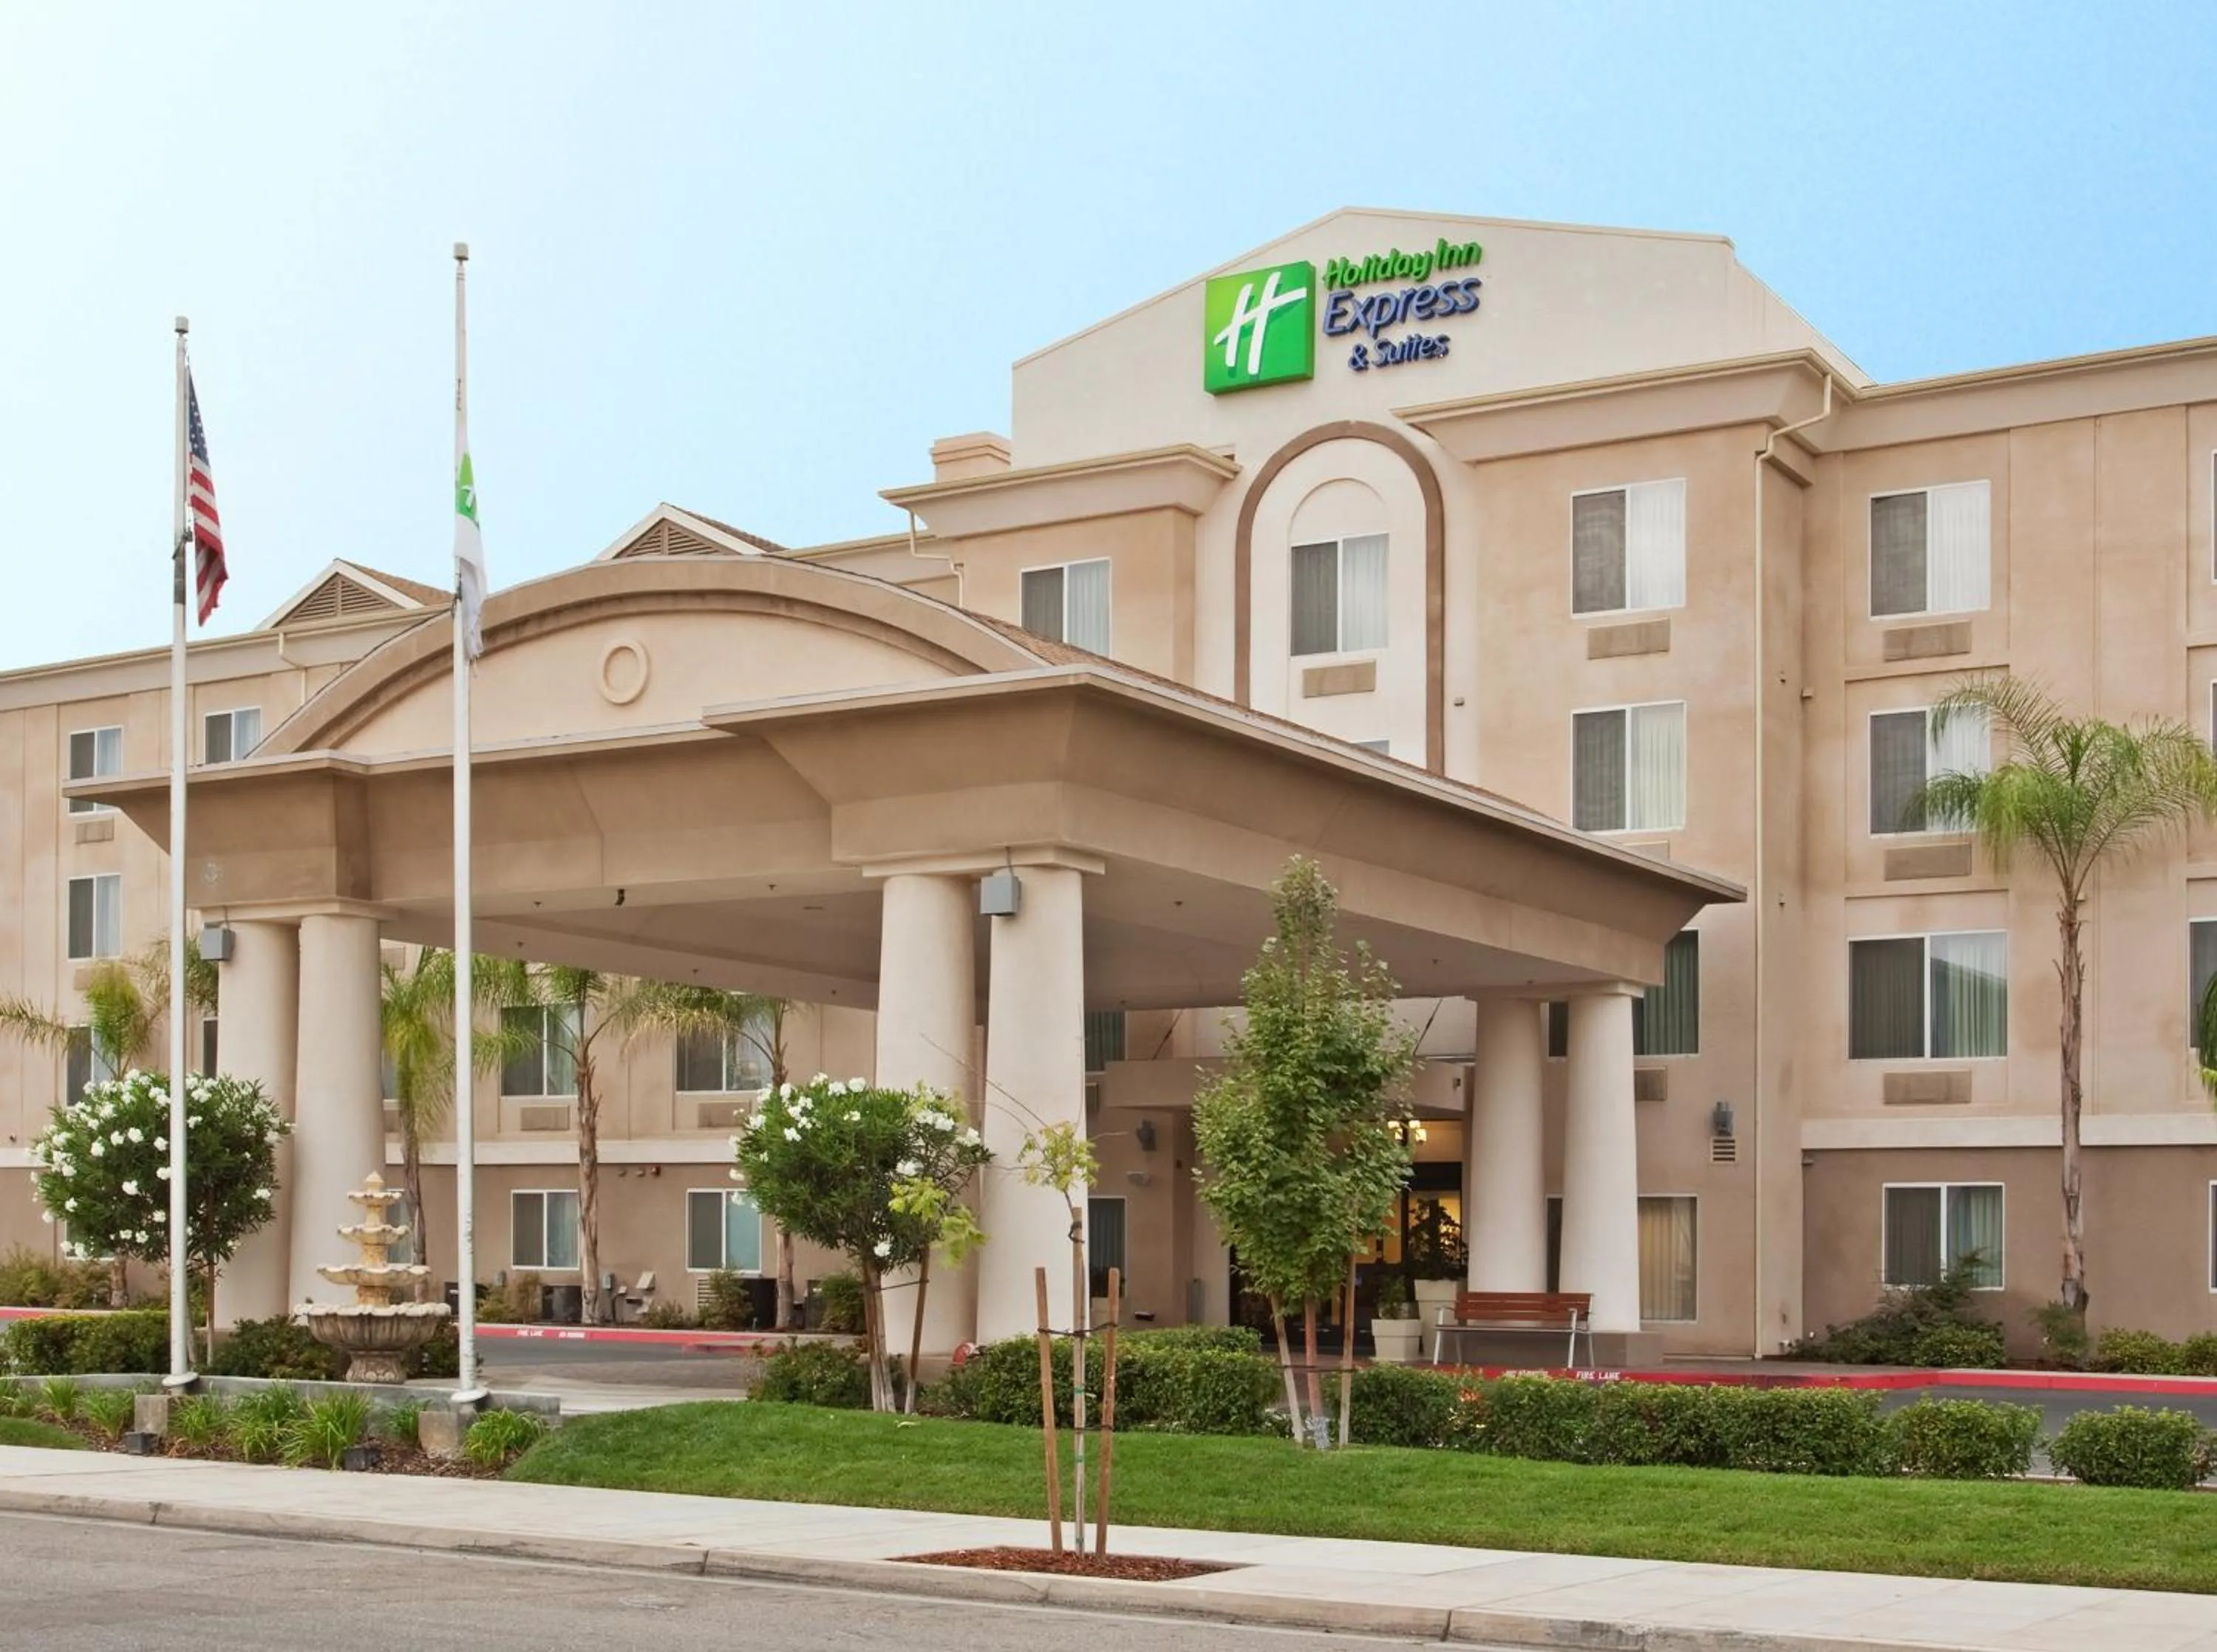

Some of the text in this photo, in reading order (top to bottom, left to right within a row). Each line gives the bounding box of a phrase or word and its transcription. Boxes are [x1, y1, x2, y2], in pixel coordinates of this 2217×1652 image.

[1323, 238, 1482, 290] Holiday Inn
[1323, 277, 1482, 339] Express
[1348, 333, 1451, 372] & Suites
